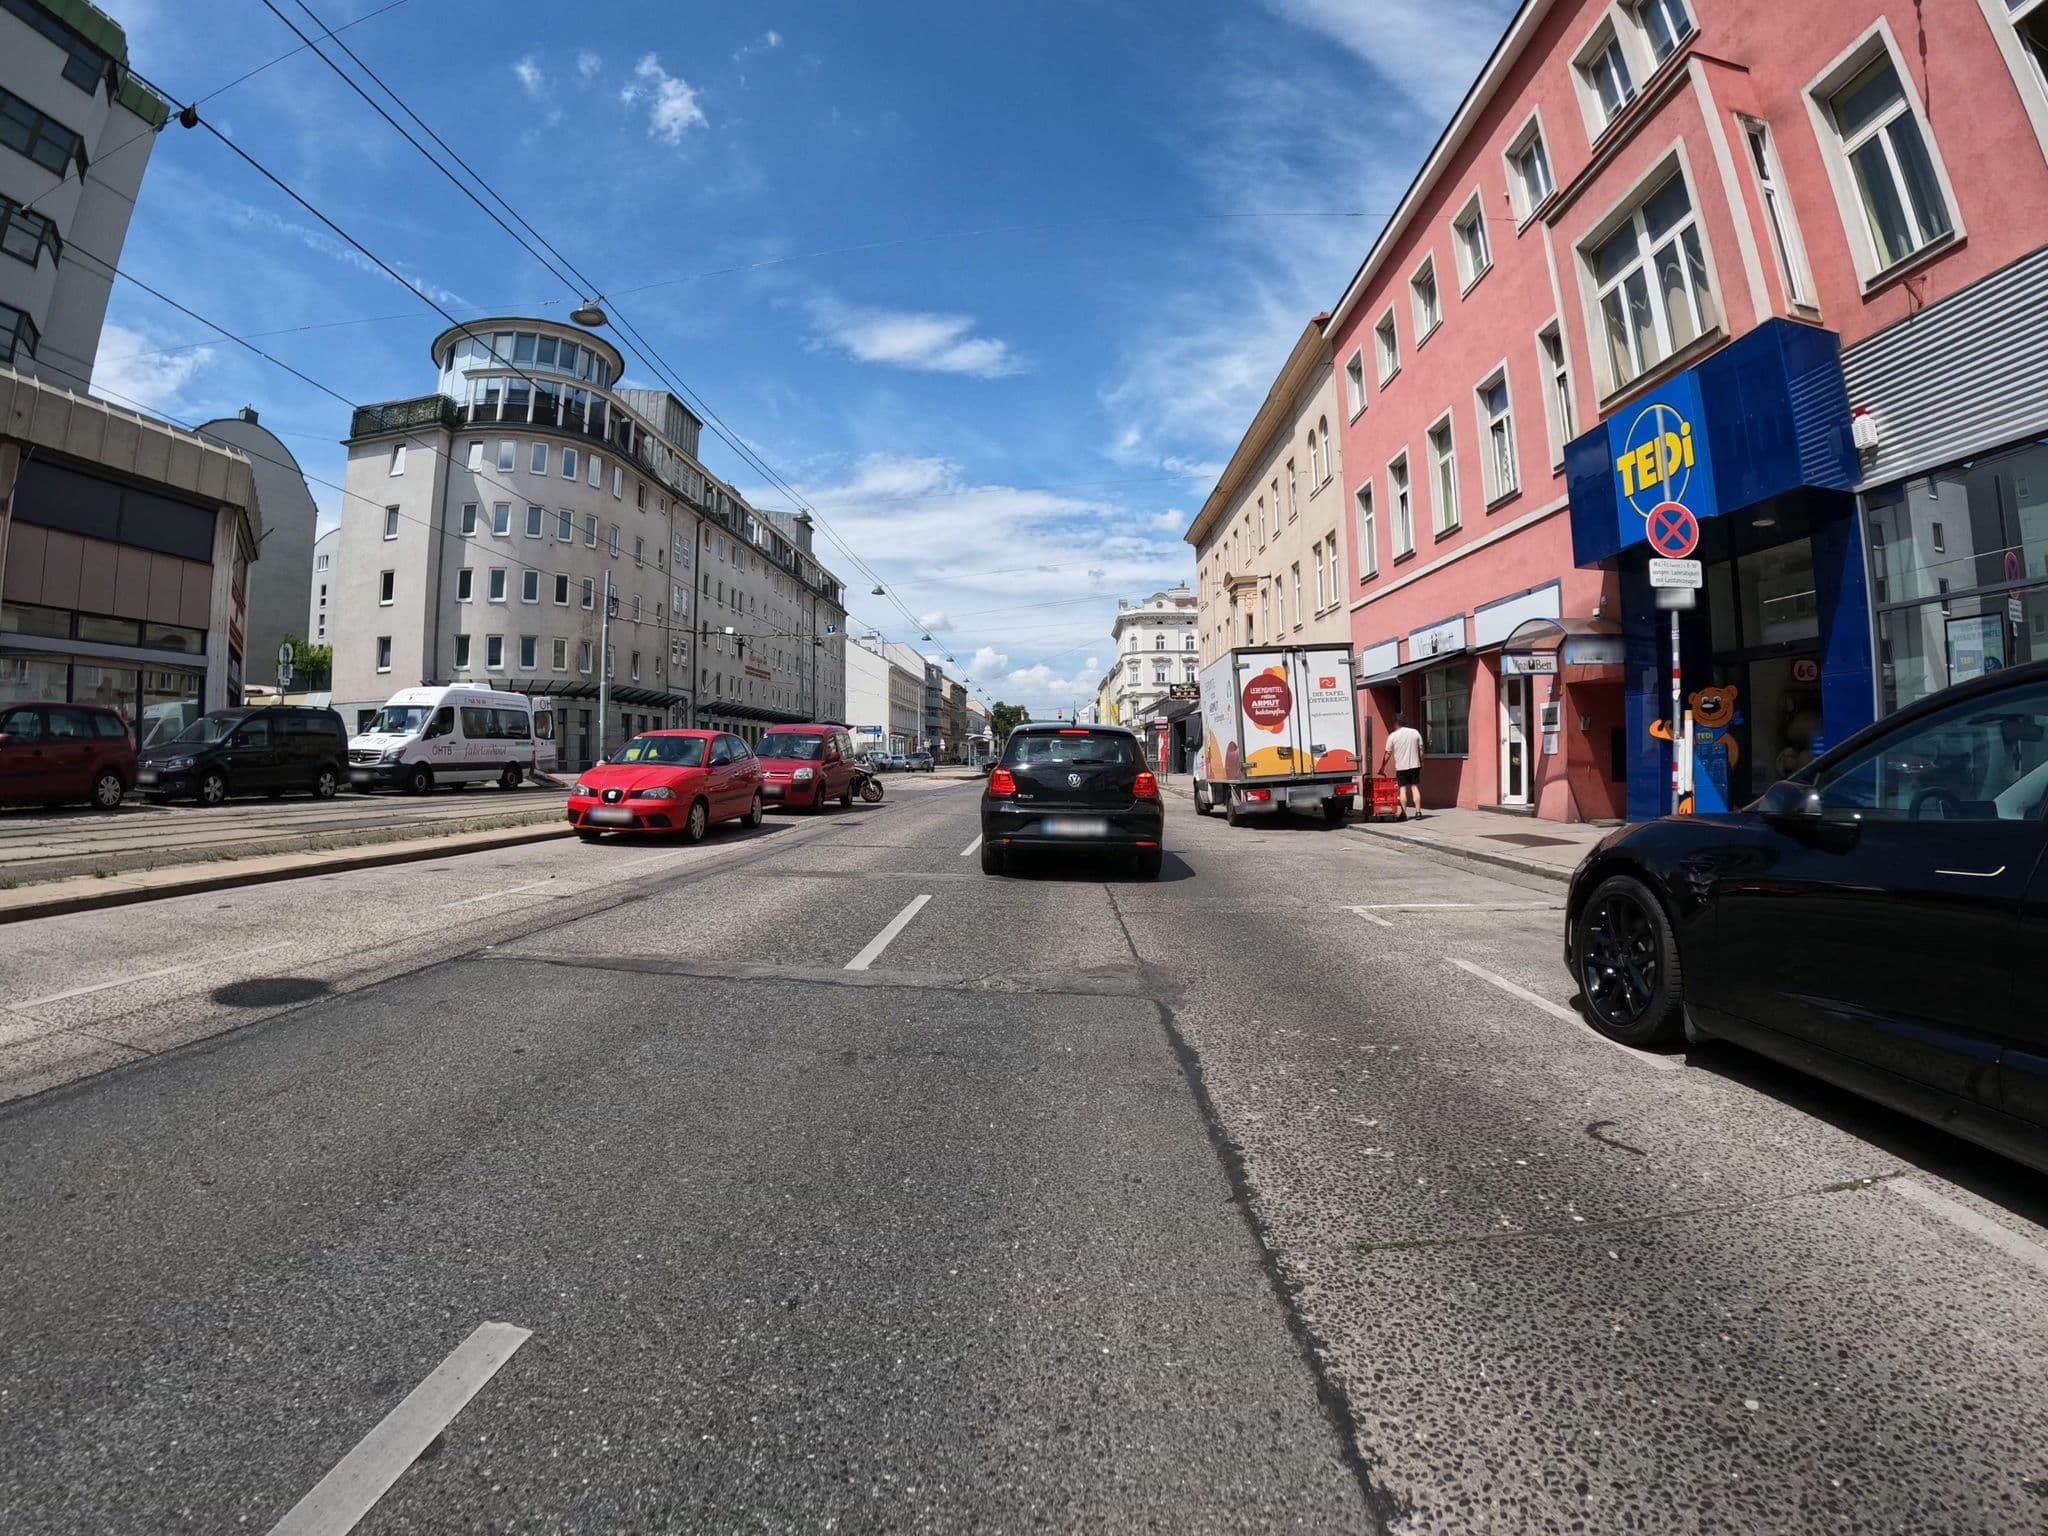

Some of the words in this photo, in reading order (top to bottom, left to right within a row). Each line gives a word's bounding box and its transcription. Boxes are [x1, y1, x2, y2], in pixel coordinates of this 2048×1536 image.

[1616, 421, 1695, 498] TEDi
[1535, 659, 1553, 671] Bett
[1250, 686, 1283, 694] LEBENSMITTEL
[1251, 699, 1280, 707] ARMUT
